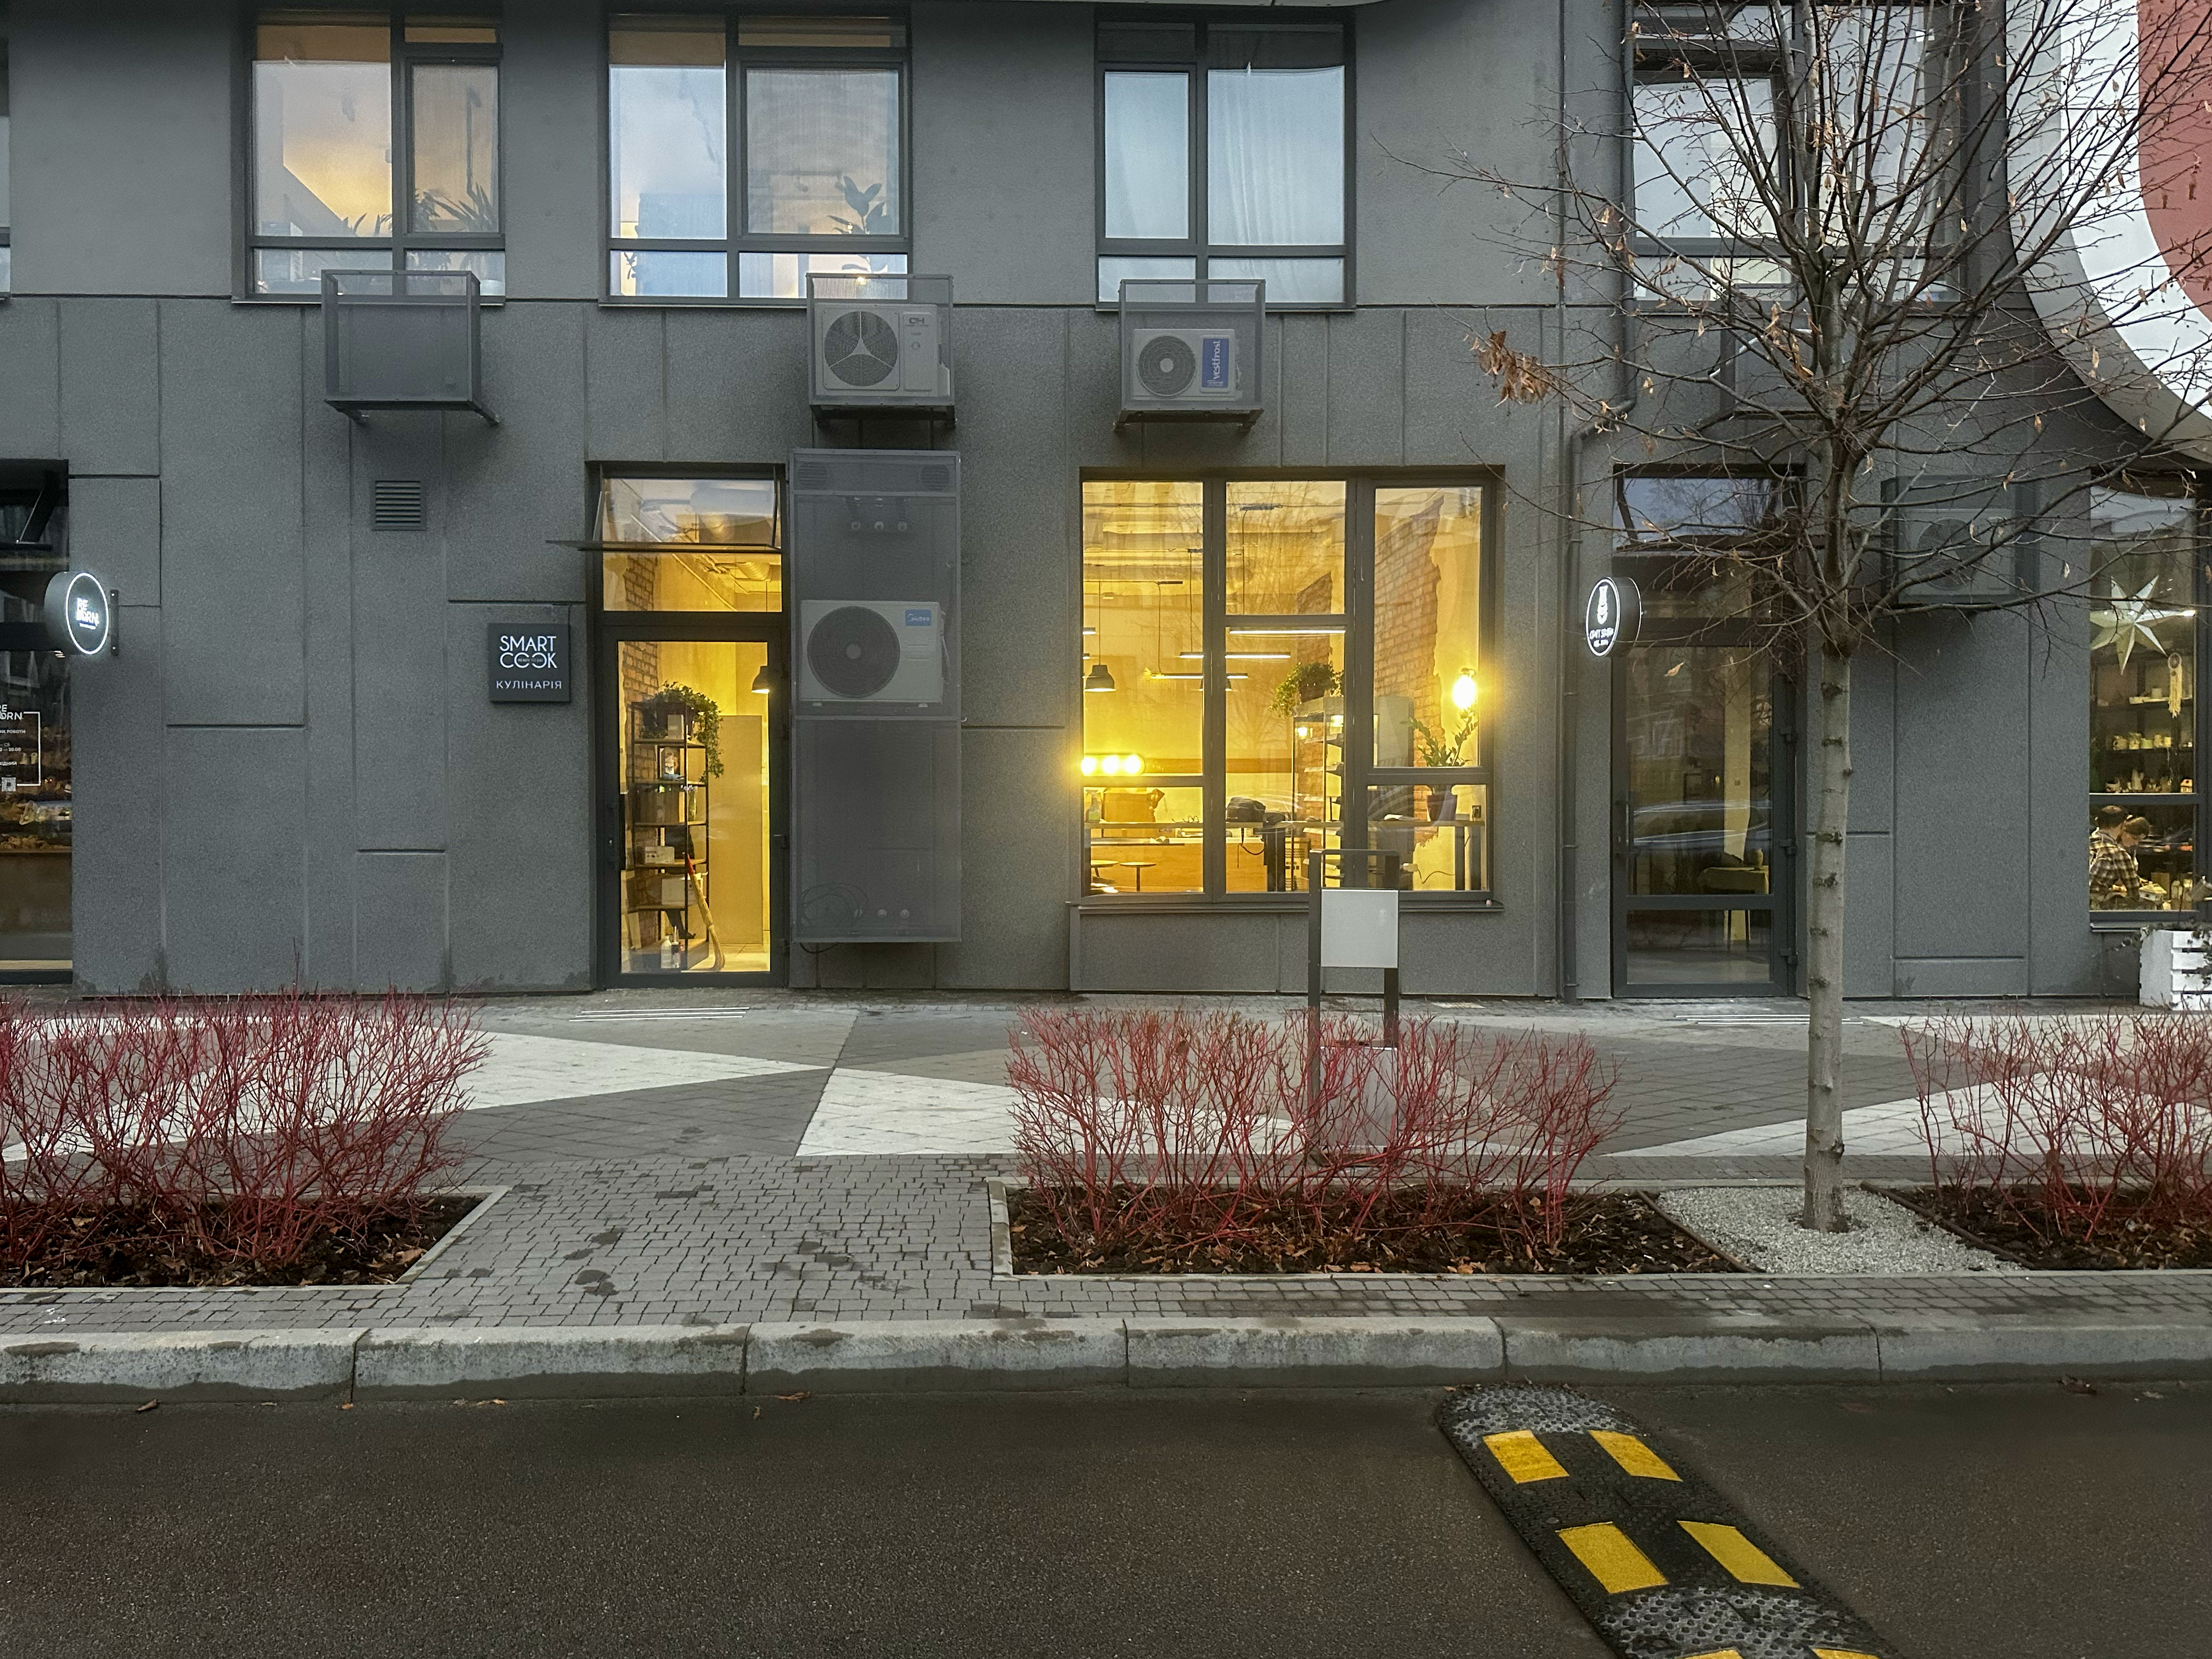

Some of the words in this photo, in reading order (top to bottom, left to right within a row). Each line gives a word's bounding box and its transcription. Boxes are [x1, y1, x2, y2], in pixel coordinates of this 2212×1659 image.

[1212, 340, 1221, 380] vestfrost
[499, 635, 557, 652] SMART
[496, 680, 562, 689] КУЛІНАРІЯ
[0, 704, 8, 712] E
[0, 712, 22, 720] ORN
